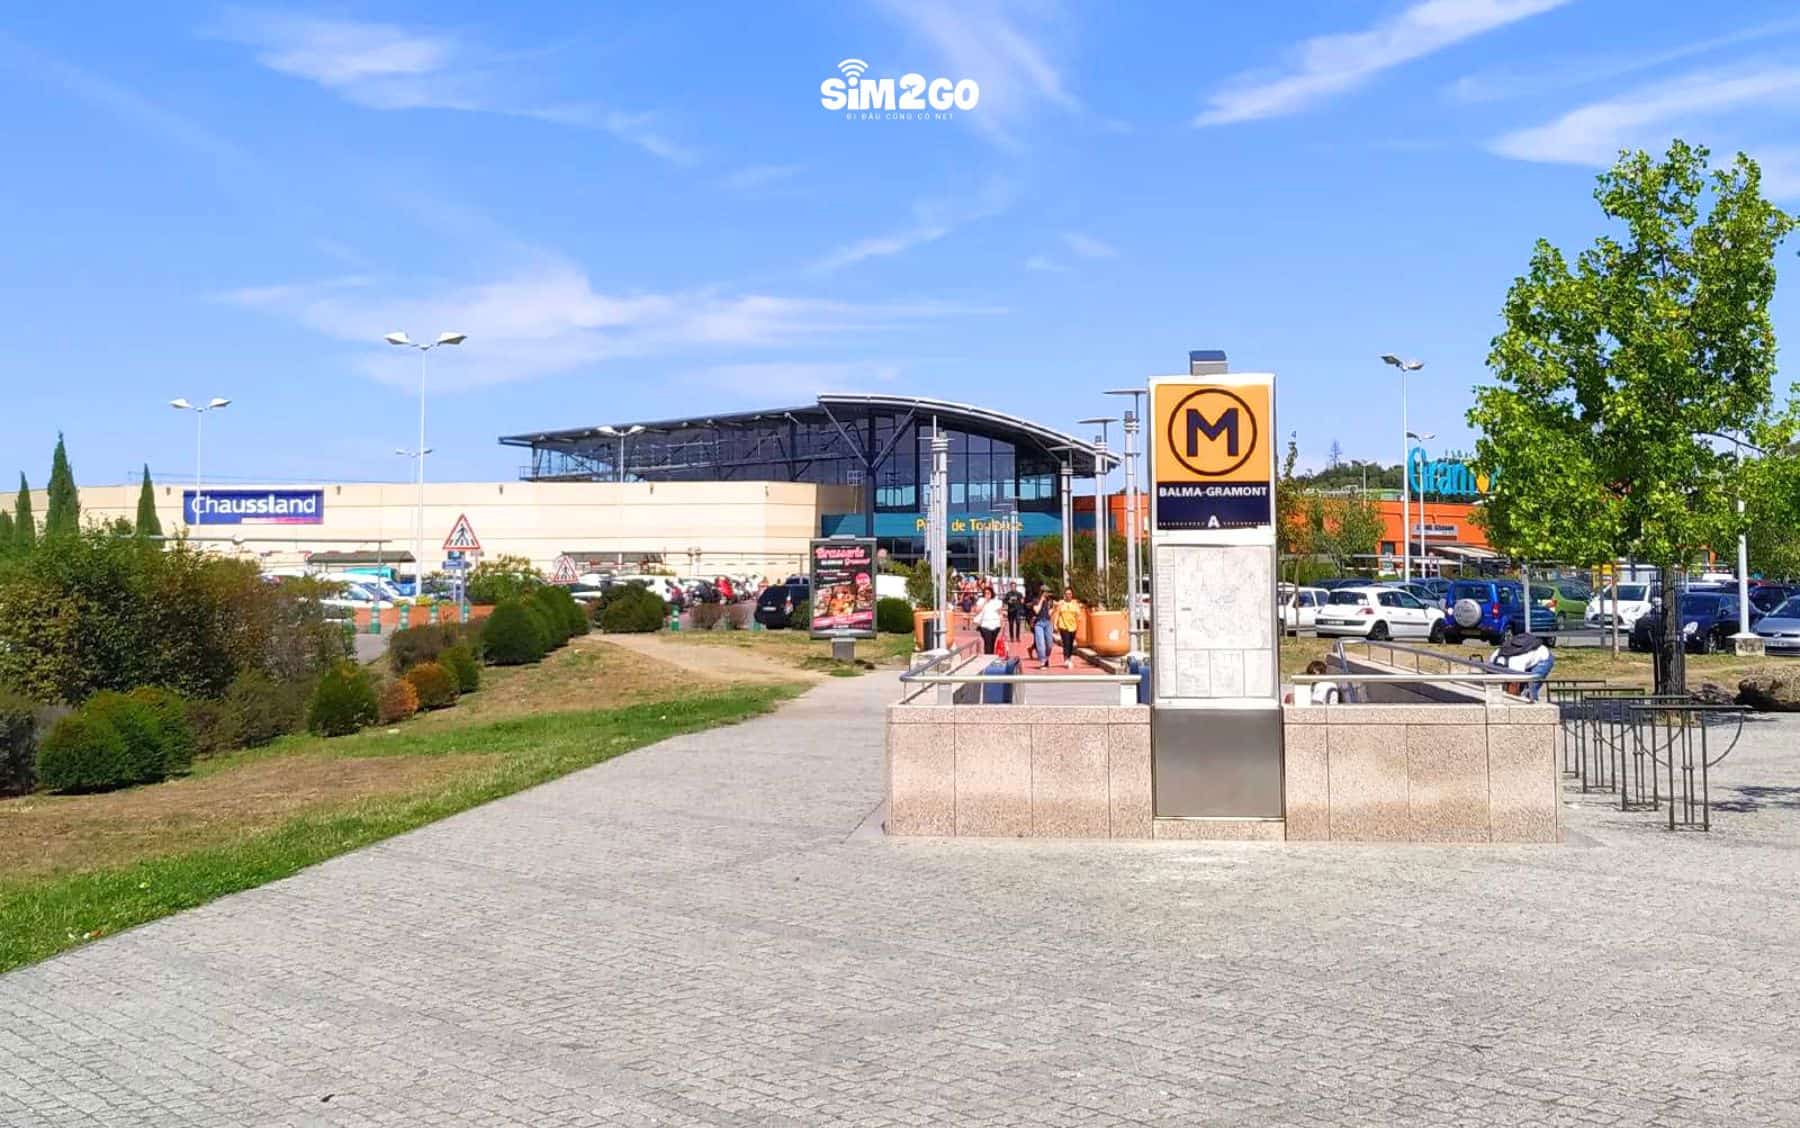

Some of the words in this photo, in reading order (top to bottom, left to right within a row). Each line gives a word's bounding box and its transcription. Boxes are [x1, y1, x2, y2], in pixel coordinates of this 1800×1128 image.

[1186, 408, 1239, 457] M
[1159, 486, 1268, 498] BALMA-GRAMONT
[191, 493, 316, 514] Chaussland
[951, 519, 966, 532] de
[969, 518, 1024, 532] Touloue
[1207, 514, 1221, 528] A
